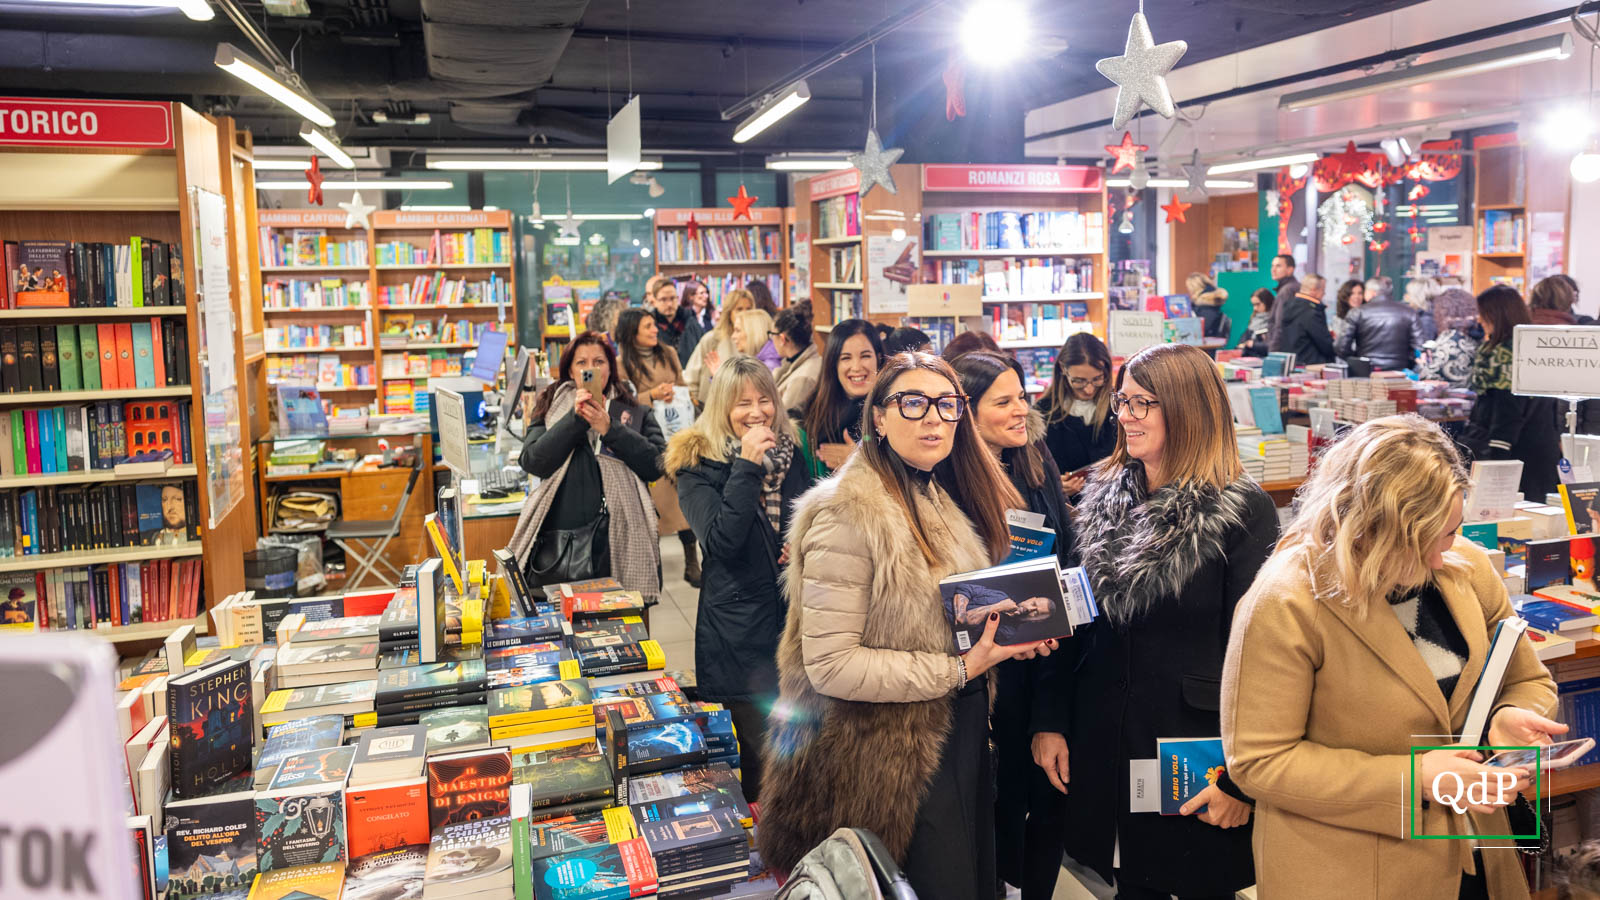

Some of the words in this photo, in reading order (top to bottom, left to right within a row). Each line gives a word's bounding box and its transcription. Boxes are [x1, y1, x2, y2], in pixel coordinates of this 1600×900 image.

[969, 171, 1026, 185] ROMANZI
[1028, 171, 1060, 184] ROSA
[260, 214, 299, 223] BAMBINI
[304, 214, 347, 223] CARTONA
[396, 215, 434, 224] BAMBINI
[437, 215, 487, 224] CARTONATI
[1538, 334, 1598, 348] NOVITÀ
[1528, 358, 1600, 368] NARRATIV
[190, 666, 247, 697] STEPHEN
[191, 682, 248, 720] KING
[466, 768, 476, 776] IL
[437, 775, 508, 794] MAESTRO
[434, 797, 450, 807] DI
[366, 811, 410, 822] CONGELATO
[444, 816, 511, 833] PRESTON
[184, 834, 210, 842] DELITTO
[212, 831, 240, 839] ALL'ORA
[447, 826, 492, 839] CHILD
[458, 831, 496, 843] STRADA
[498, 826, 510, 834] DI
[206, 838, 233, 846] VESPRO
[282, 842, 320, 850] DELL'INVERNO
[434, 841, 471, 853] SABBIA
[485, 833, 510, 842] OSSA
[272, 865, 332, 878] ARNALDUR
